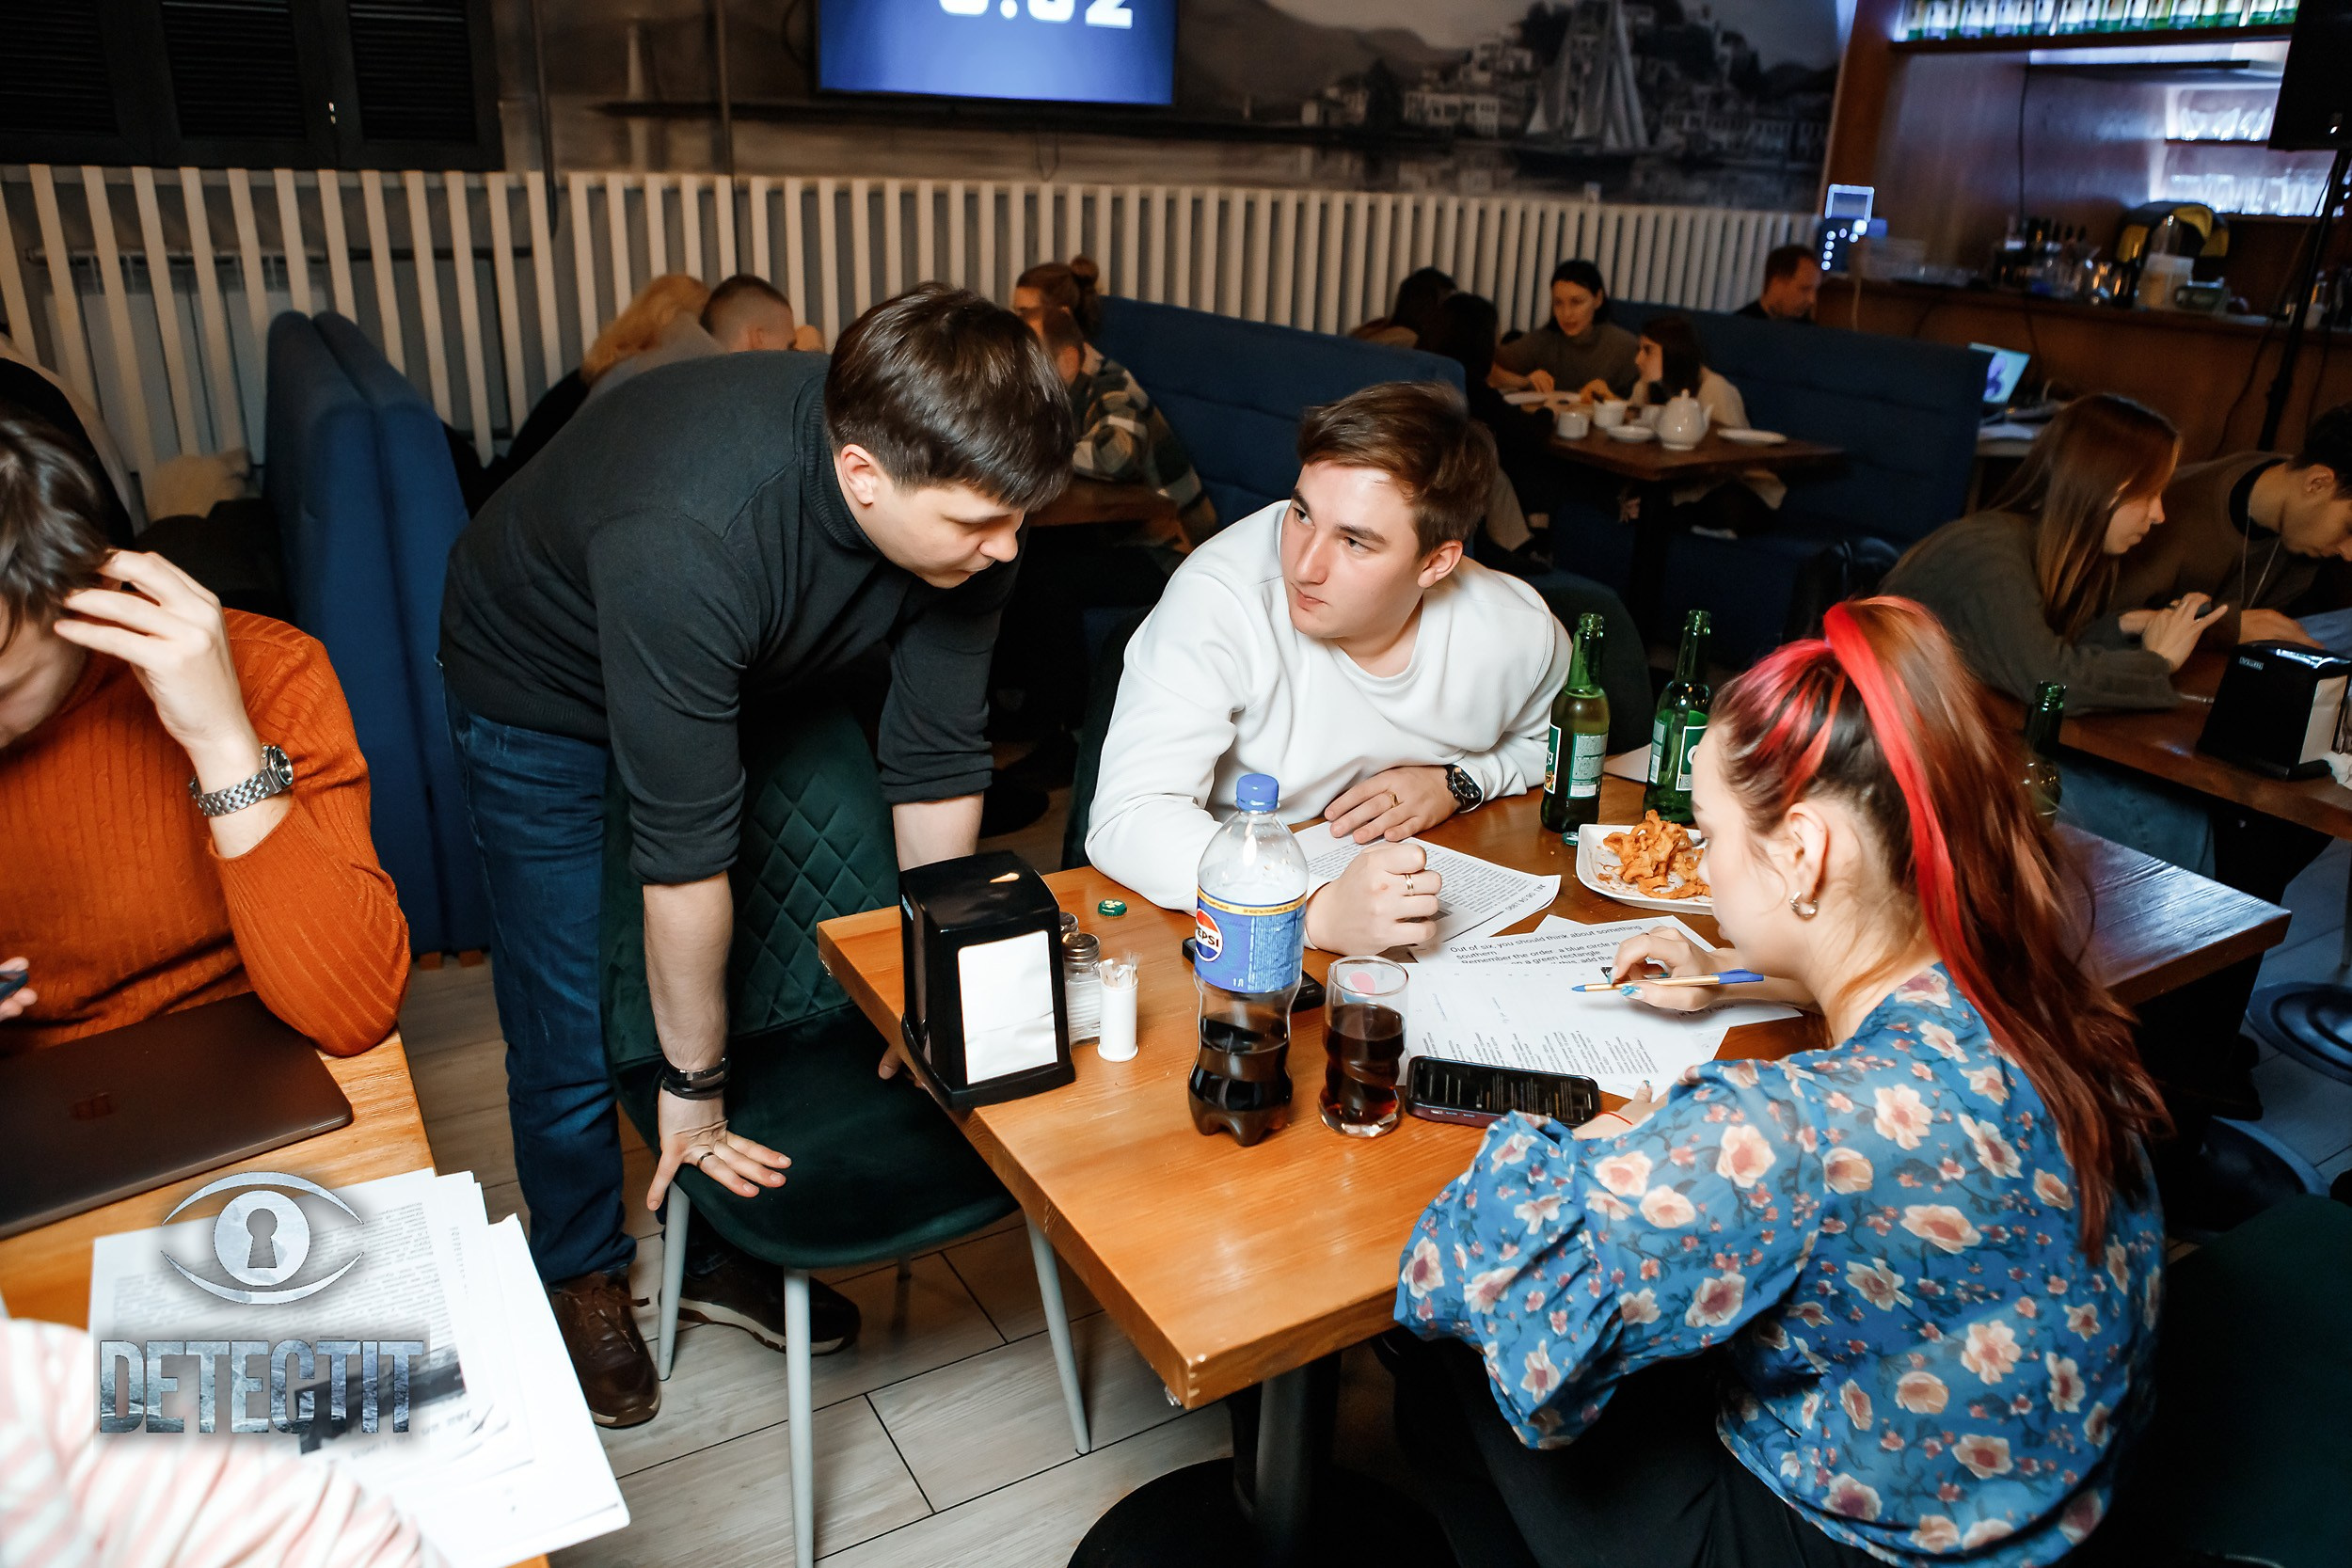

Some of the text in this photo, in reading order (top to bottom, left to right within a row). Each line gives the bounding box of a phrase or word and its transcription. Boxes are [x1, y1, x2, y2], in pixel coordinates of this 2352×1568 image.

[1196, 926, 1220, 948] EPSI
[1516, 936, 1546, 944] should
[1570, 930, 1596, 939] about
[1596, 925, 1643, 935] something
[1586, 942, 1611, 950] circle
[1533, 955, 1559, 964] green
[1581, 956, 1598, 964] add
